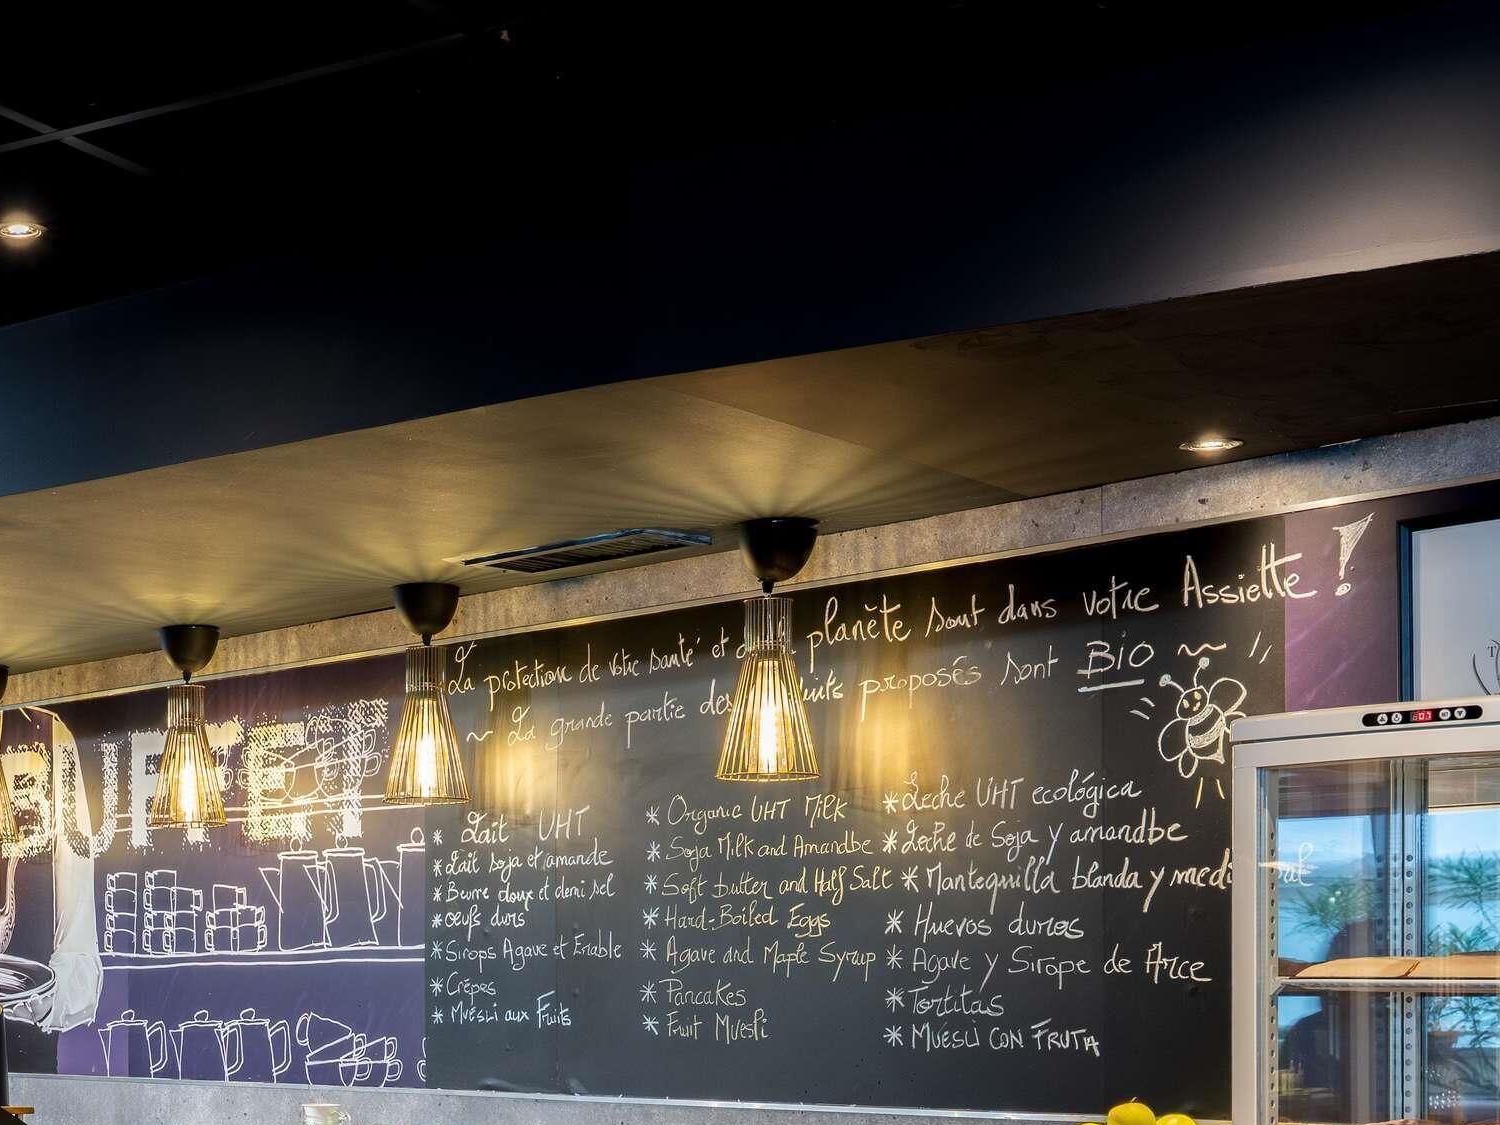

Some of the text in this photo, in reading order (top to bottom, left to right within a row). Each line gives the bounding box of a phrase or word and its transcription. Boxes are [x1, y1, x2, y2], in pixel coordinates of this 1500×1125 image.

[484, 659, 572, 711] protection
[579, 643, 600, 683] de
[712, 626, 730, 658] et
[998, 583, 1058, 624] dans
[1183, 542, 1318, 609] Assiette
[545, 701, 613, 751] grande
[625, 691, 686, 749] partie
[858, 655, 982, 722] proposés
[976, 777, 1025, 809] UHT
[1032, 769, 1143, 818] ecológica
[461, 805, 591, 844] Lait UHT
[667, 794, 743, 835] Organic
[751, 795, 792, 823] UHT
[966, 819, 982, 849] de
[527, 845, 544, 870] et
[546, 837, 615, 866] amande
[758, 834, 787, 857] and
[497, 882, 535, 912] doux
[539, 875, 550, 901] et
[555, 874, 586, 900] demi
[661, 872, 708, 904] Soft
[779, 865, 808, 895] and
[815, 865, 848, 906] Half
[850, 864, 894, 891] Salt
[1071, 855, 1144, 891] blanda
[664, 900, 832, 938] Hard-Boiled Eggs
[913, 901, 993, 943] Huevos
[445, 939, 497, 974] Sirops
[503, 937, 549, 971] Agave
[553, 934, 569, 960] et
[666, 935, 877, 982] Agave and Maple Syrup
[912, 946, 972, 985] Agave
[1008, 945, 1092, 991] Sirope
[1103, 942, 1133, 975] de
[504, 1009, 530, 1023] aux
[536, 989, 572, 1029] Fruits
[908, 983, 1005, 1018] Tortitas
